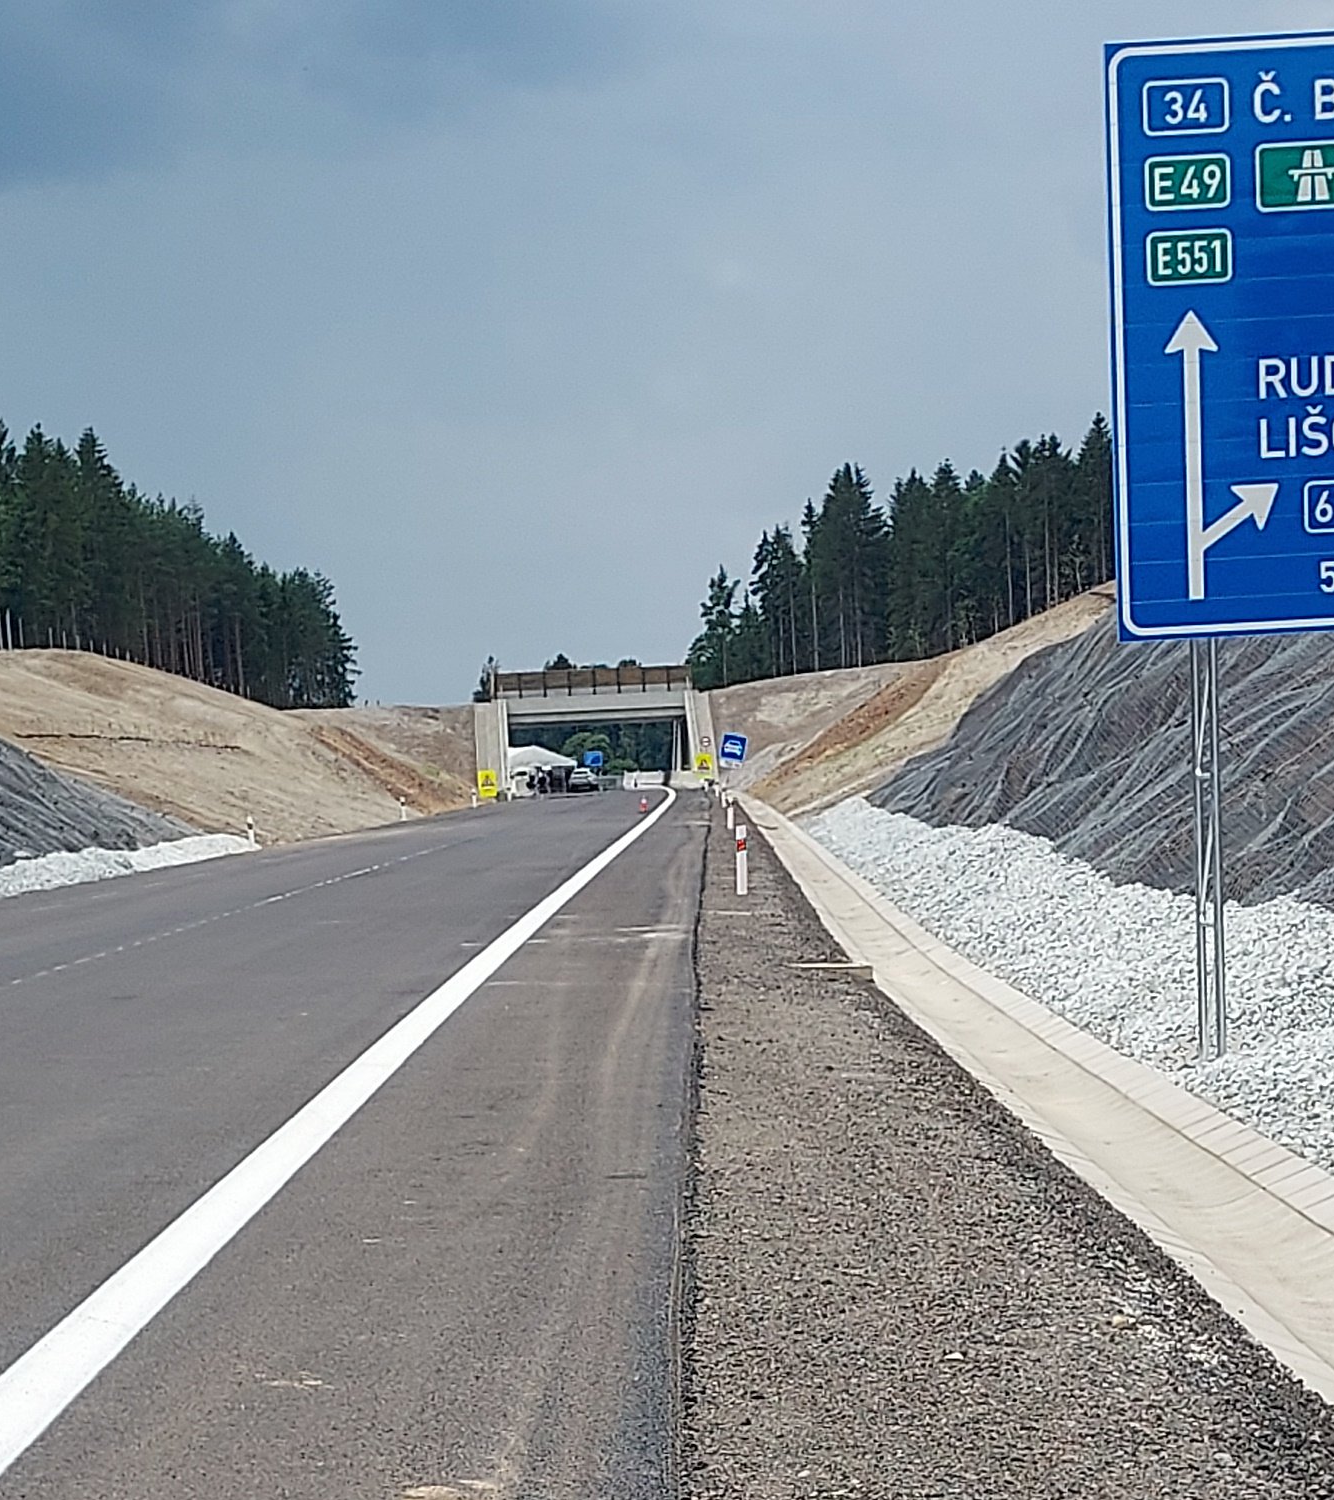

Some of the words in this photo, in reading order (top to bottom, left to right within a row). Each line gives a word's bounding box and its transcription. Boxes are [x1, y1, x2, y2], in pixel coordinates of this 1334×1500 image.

[1164, 89, 1208, 125] 34
[1253, 71, 1292, 124] Č.
[1153, 164, 1222, 201] E49
[1157, 239, 1222, 276] E551
